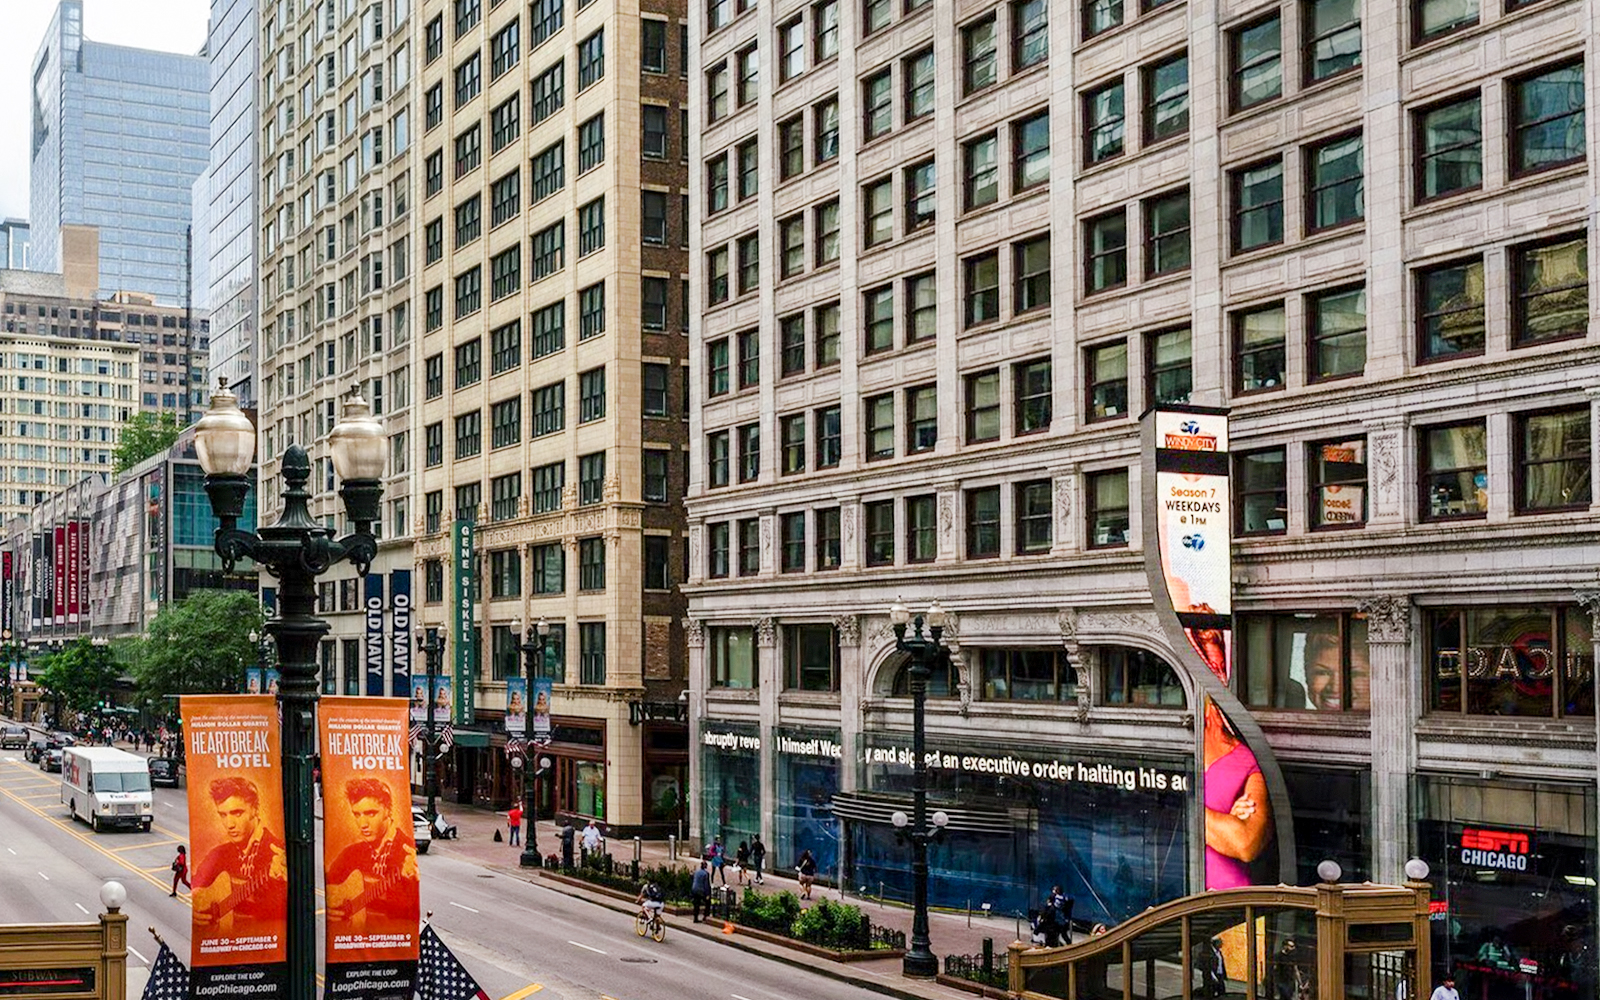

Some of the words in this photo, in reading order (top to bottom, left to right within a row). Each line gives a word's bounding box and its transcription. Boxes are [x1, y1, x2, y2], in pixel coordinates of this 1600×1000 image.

[1166, 436, 1194, 446] WINDY
[1196, 438, 1217, 448] CITY
[1171, 486, 1207, 498] Season
[1210, 489, 1216, 498] 7
[1166, 500, 1221, 513] WEEKDAYS
[1190, 514, 1207, 525] 1PM
[462, 526, 470, 569] GENE
[4, 552, 12, 579] amc
[33, 558, 42, 599] francesca's
[368, 597, 382, 628] OLD
[394, 594, 409, 627] OLD
[462, 577, 470, 642] SISKEL
[368, 632, 382, 677] NAVY
[394, 632, 409, 678] NAVY
[191, 730, 270, 754] HEARTBREAK
[328, 732, 403, 756] HEARTBREAK
[216, 754, 271, 768] HOTEL
[352, 756, 404, 770] HOTEL
[704, 730, 738, 750] abruptly
[740, 736, 760, 749] reve
[782, 738, 818, 755] himself
[874, 746, 896, 763] and
[898, 748, 941, 769] siged
[943, 754, 959, 769] an
[962, 756, 1030, 776] executive
[1032, 760, 1074, 781] order
[1078, 762, 1136, 790] halting
[1139, 767, 1167, 790] his
[1461, 828, 1530, 854] ESPN
[1461, 848, 1527, 871] CHICAGO
[236, 936, 271, 944] SEPTEMBER
[12, 970, 58, 981] SUBWAY
[211, 974, 236, 982] EXPLORE
[249, 972, 265, 980] LOOP
[346, 970, 370, 978] EXPLORE
[196, 984, 277, 996] LoopChicago.com
[332, 980, 410, 992] LoopChicago.com
